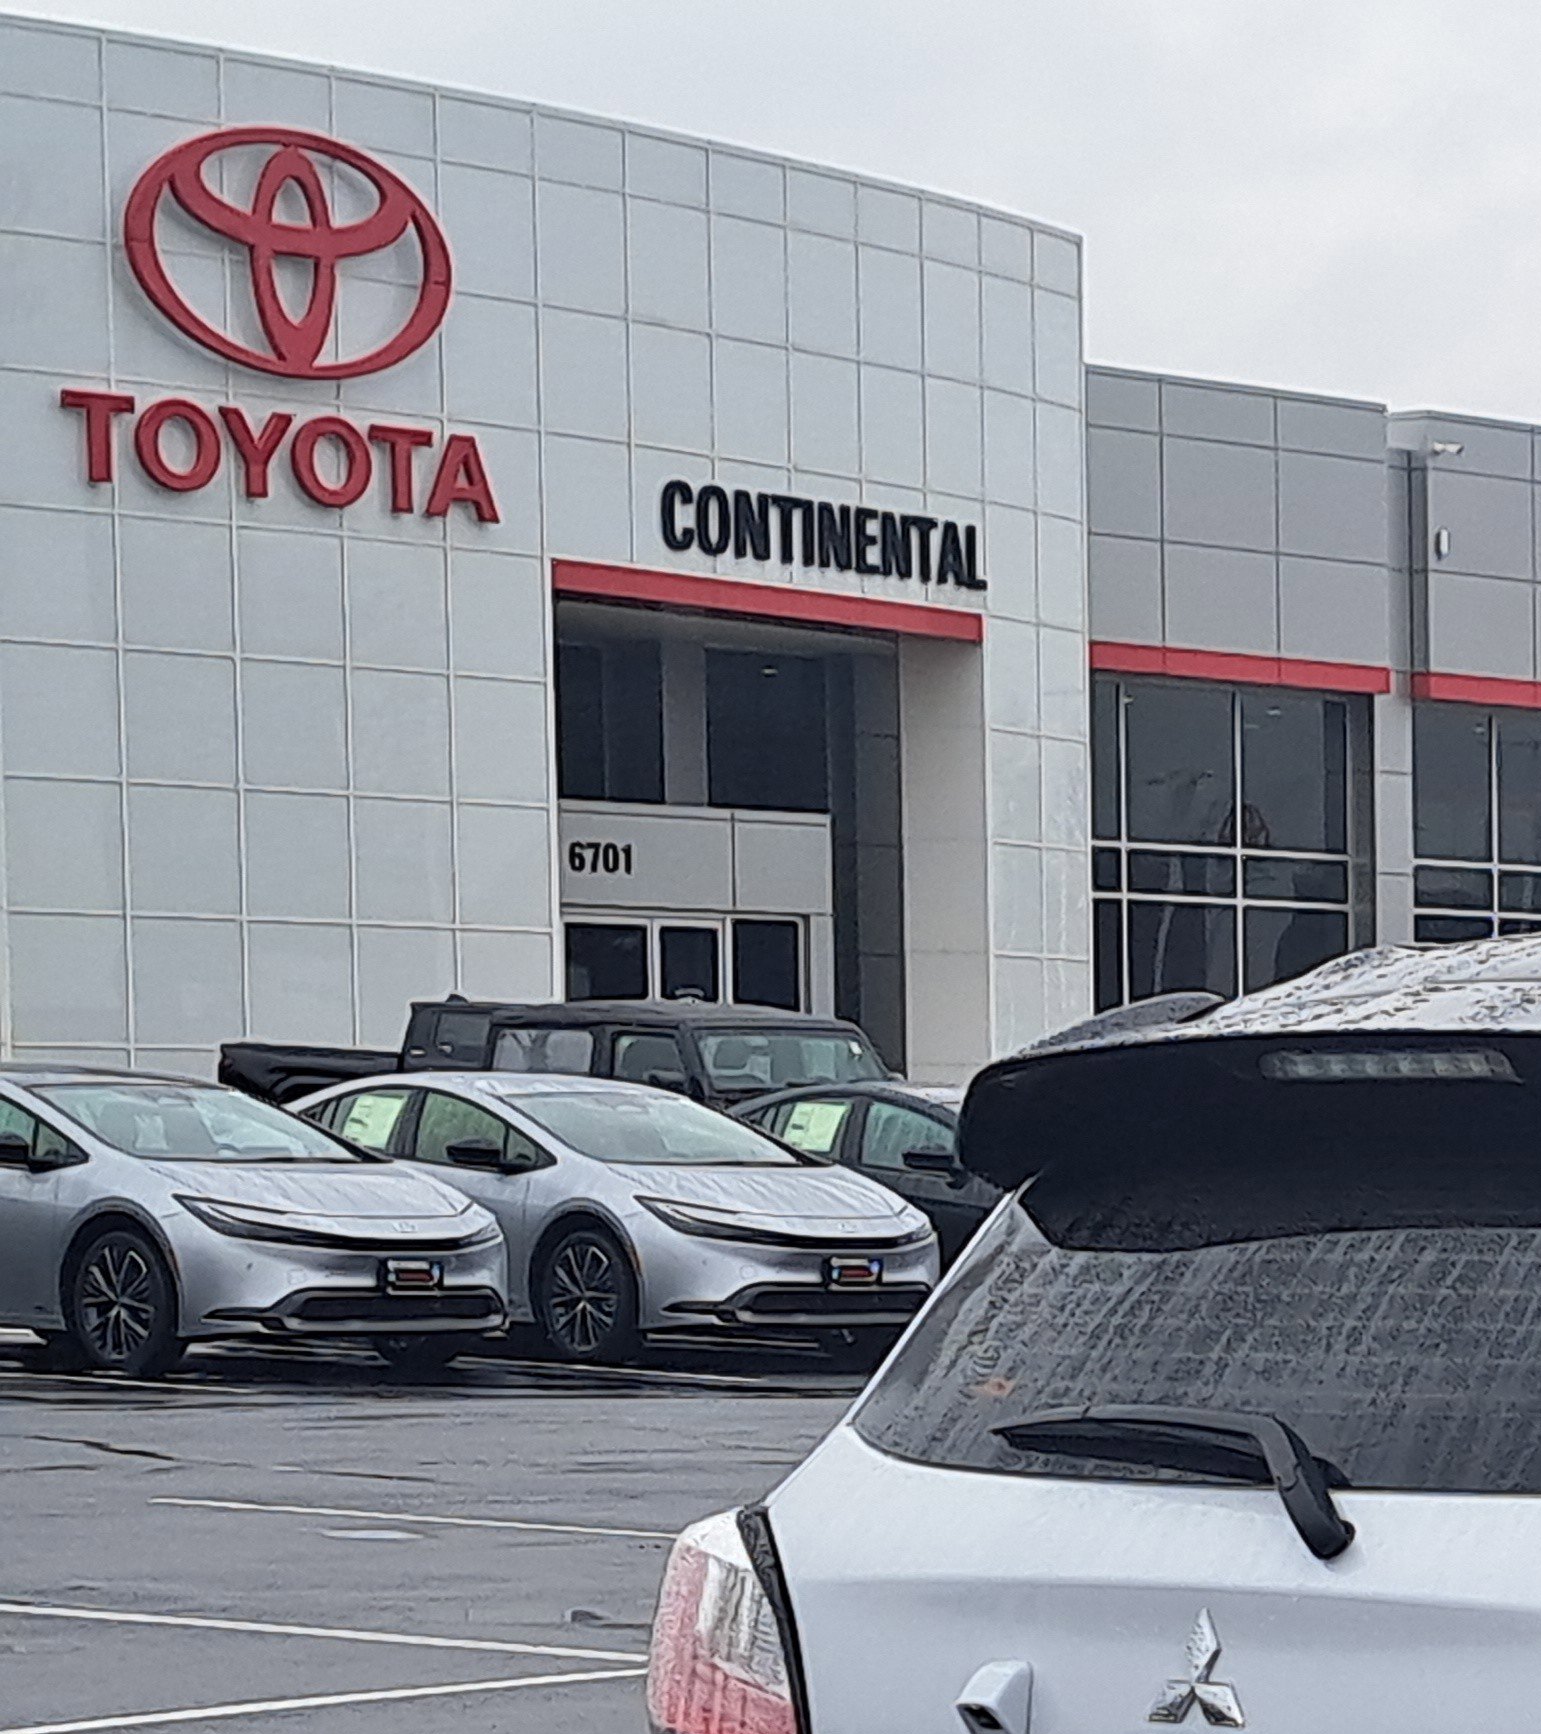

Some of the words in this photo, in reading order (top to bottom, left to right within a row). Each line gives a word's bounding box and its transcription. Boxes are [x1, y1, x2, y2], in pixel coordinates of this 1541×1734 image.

[61, 390, 500, 523] TOYOTA
[661, 480, 987, 591] CONTINENTAL
[568, 842, 633, 875] 6701
